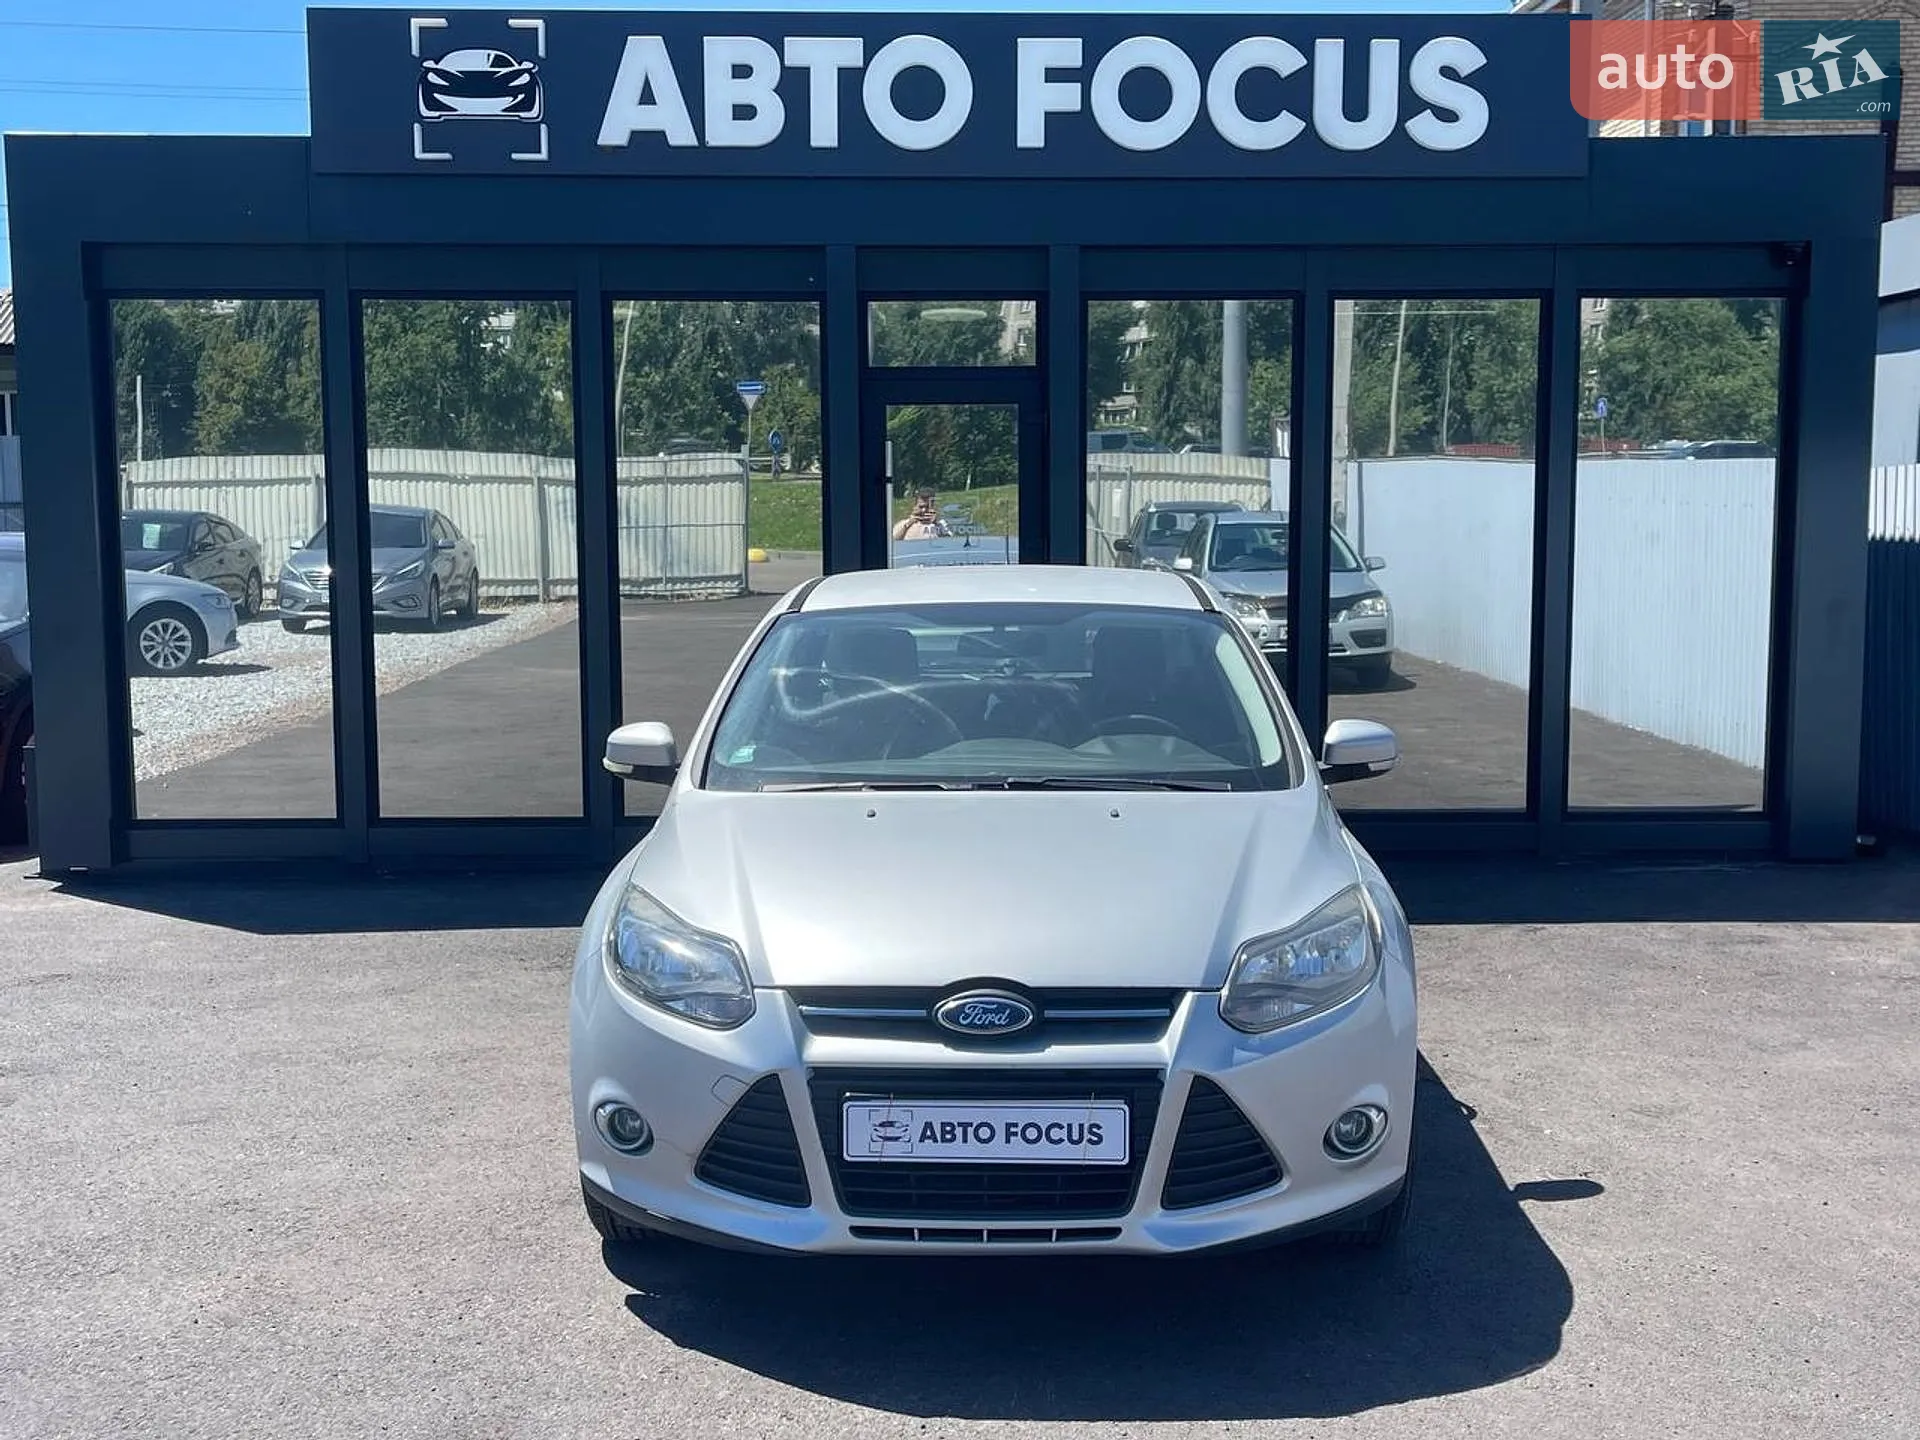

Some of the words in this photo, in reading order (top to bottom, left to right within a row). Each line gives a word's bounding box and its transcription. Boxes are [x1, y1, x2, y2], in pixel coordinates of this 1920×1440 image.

[597, 34, 973, 151] АВТО
[1016, 35, 1490, 151] FOCUS
[959, 1003, 1010, 1025] Ford
[919, 1121, 996, 1145] АВТО
[1004, 1122, 1104, 1146] FOCUS
